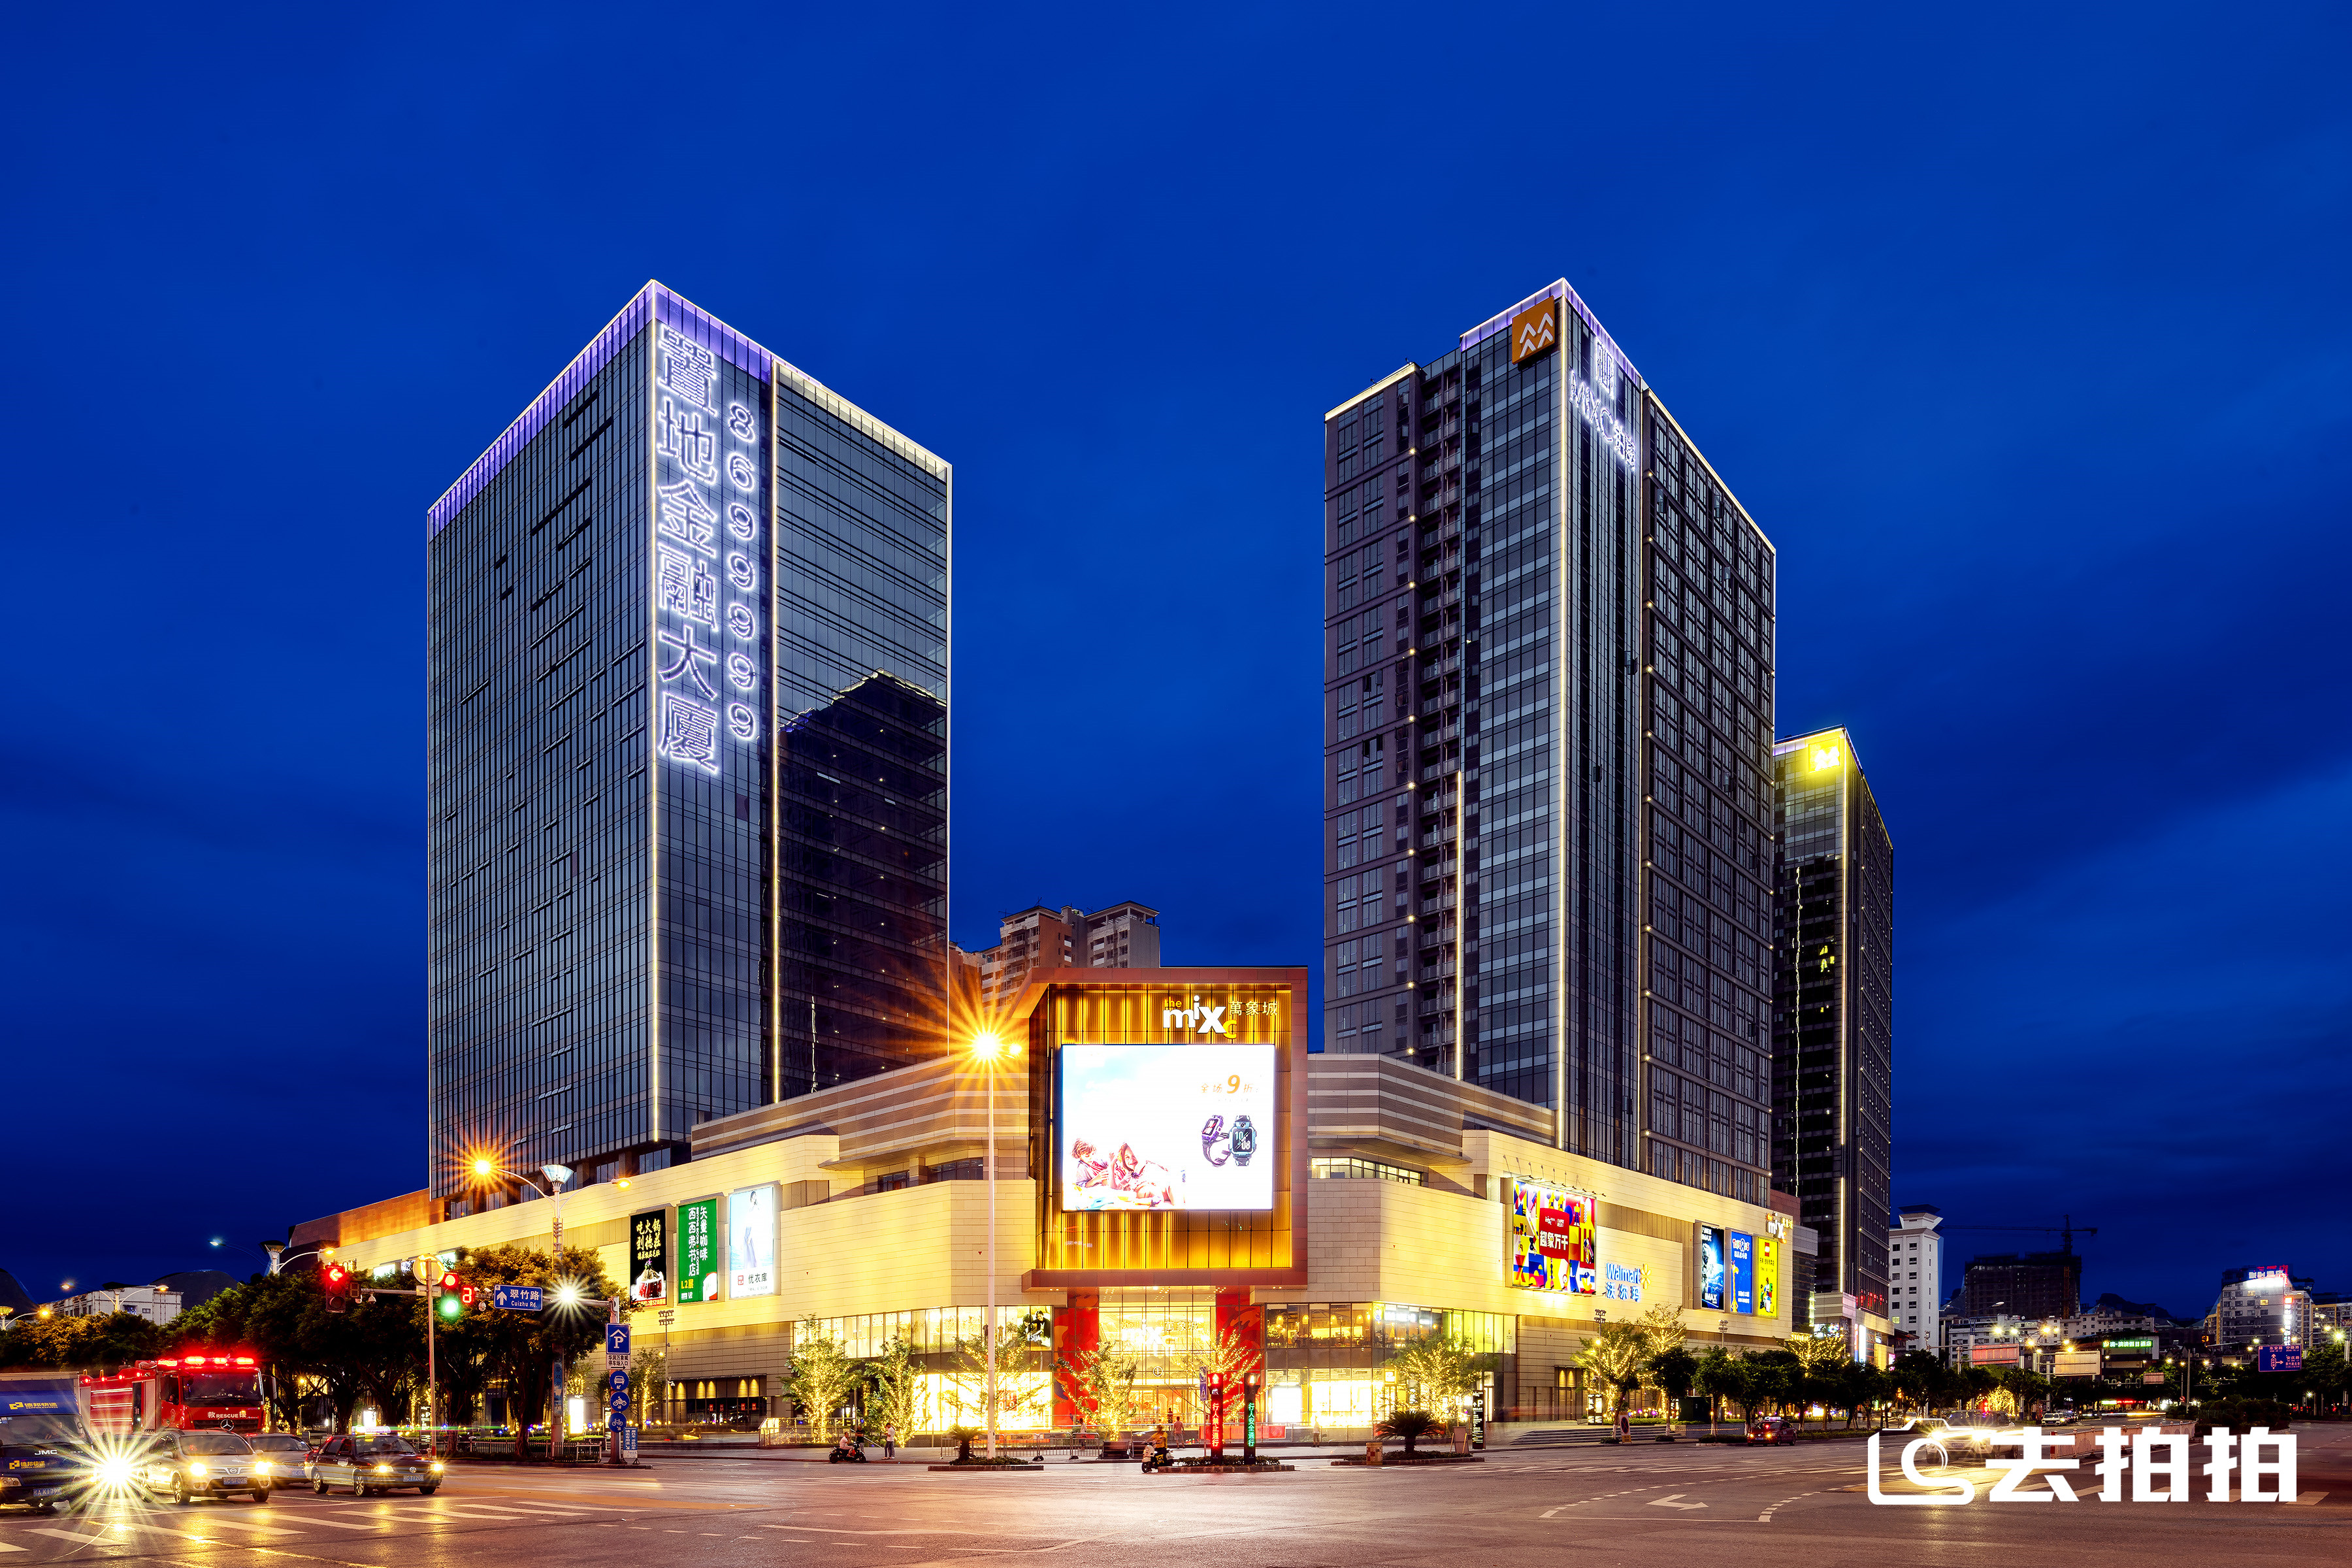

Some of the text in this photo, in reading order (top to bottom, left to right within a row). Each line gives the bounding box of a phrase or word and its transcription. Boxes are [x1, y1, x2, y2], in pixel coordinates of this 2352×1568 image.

[657, 323, 718, 774] 置地金融大厦
[728, 402, 756, 740] 8699999
[1164, 996, 1182, 1007] the
[1229, 1001, 1278, 1016] 萬象城
[688, 1207, 696, 1277] 西西弗书店
[748, 1273, 767, 1284] 优衣库
[1606, 1262, 1641, 1283] Walmart
[510, 1289, 540, 1301] 翠竹路
[1605, 1282, 1641, 1302] 沃尔玛
[1165, 1321, 1198, 1331] 萬象城
[613, 1336, 624, 1348] P
